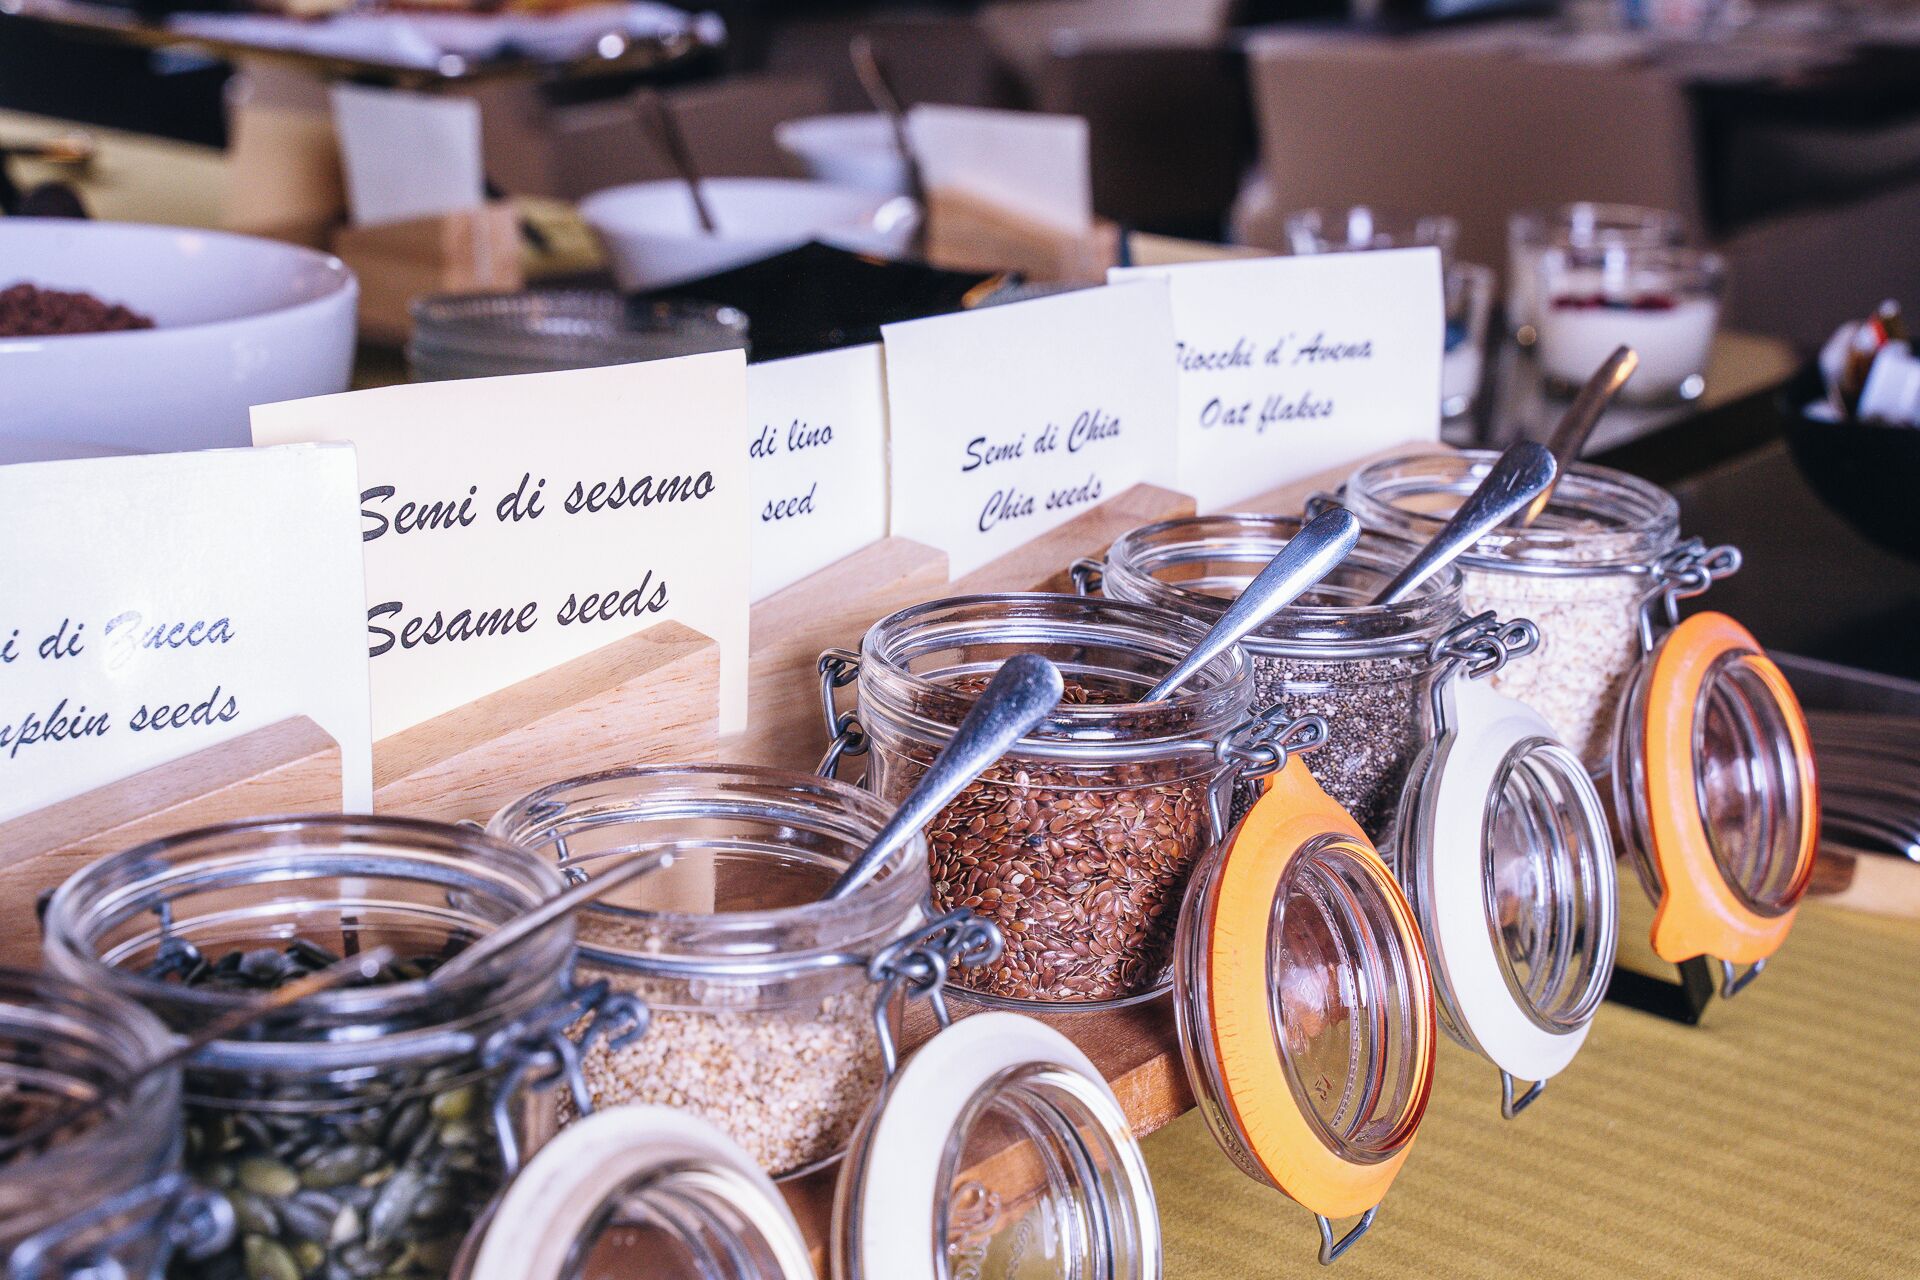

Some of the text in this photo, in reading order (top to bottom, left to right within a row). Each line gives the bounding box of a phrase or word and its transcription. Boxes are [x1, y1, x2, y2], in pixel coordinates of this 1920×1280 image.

[1200, 390, 1334, 433] Oat flakes
[749, 418, 834, 459] di lino
[961, 408, 1121, 473] Semi di Chia
[360, 470, 716, 542] Semi di sesamo
[761, 482, 818, 523] seed
[977, 474, 1103, 534] Chia seeds
[367, 569, 669, 658] Sesame seeds
[38, 618, 85, 660] di
[129, 686, 240, 733] seeds
